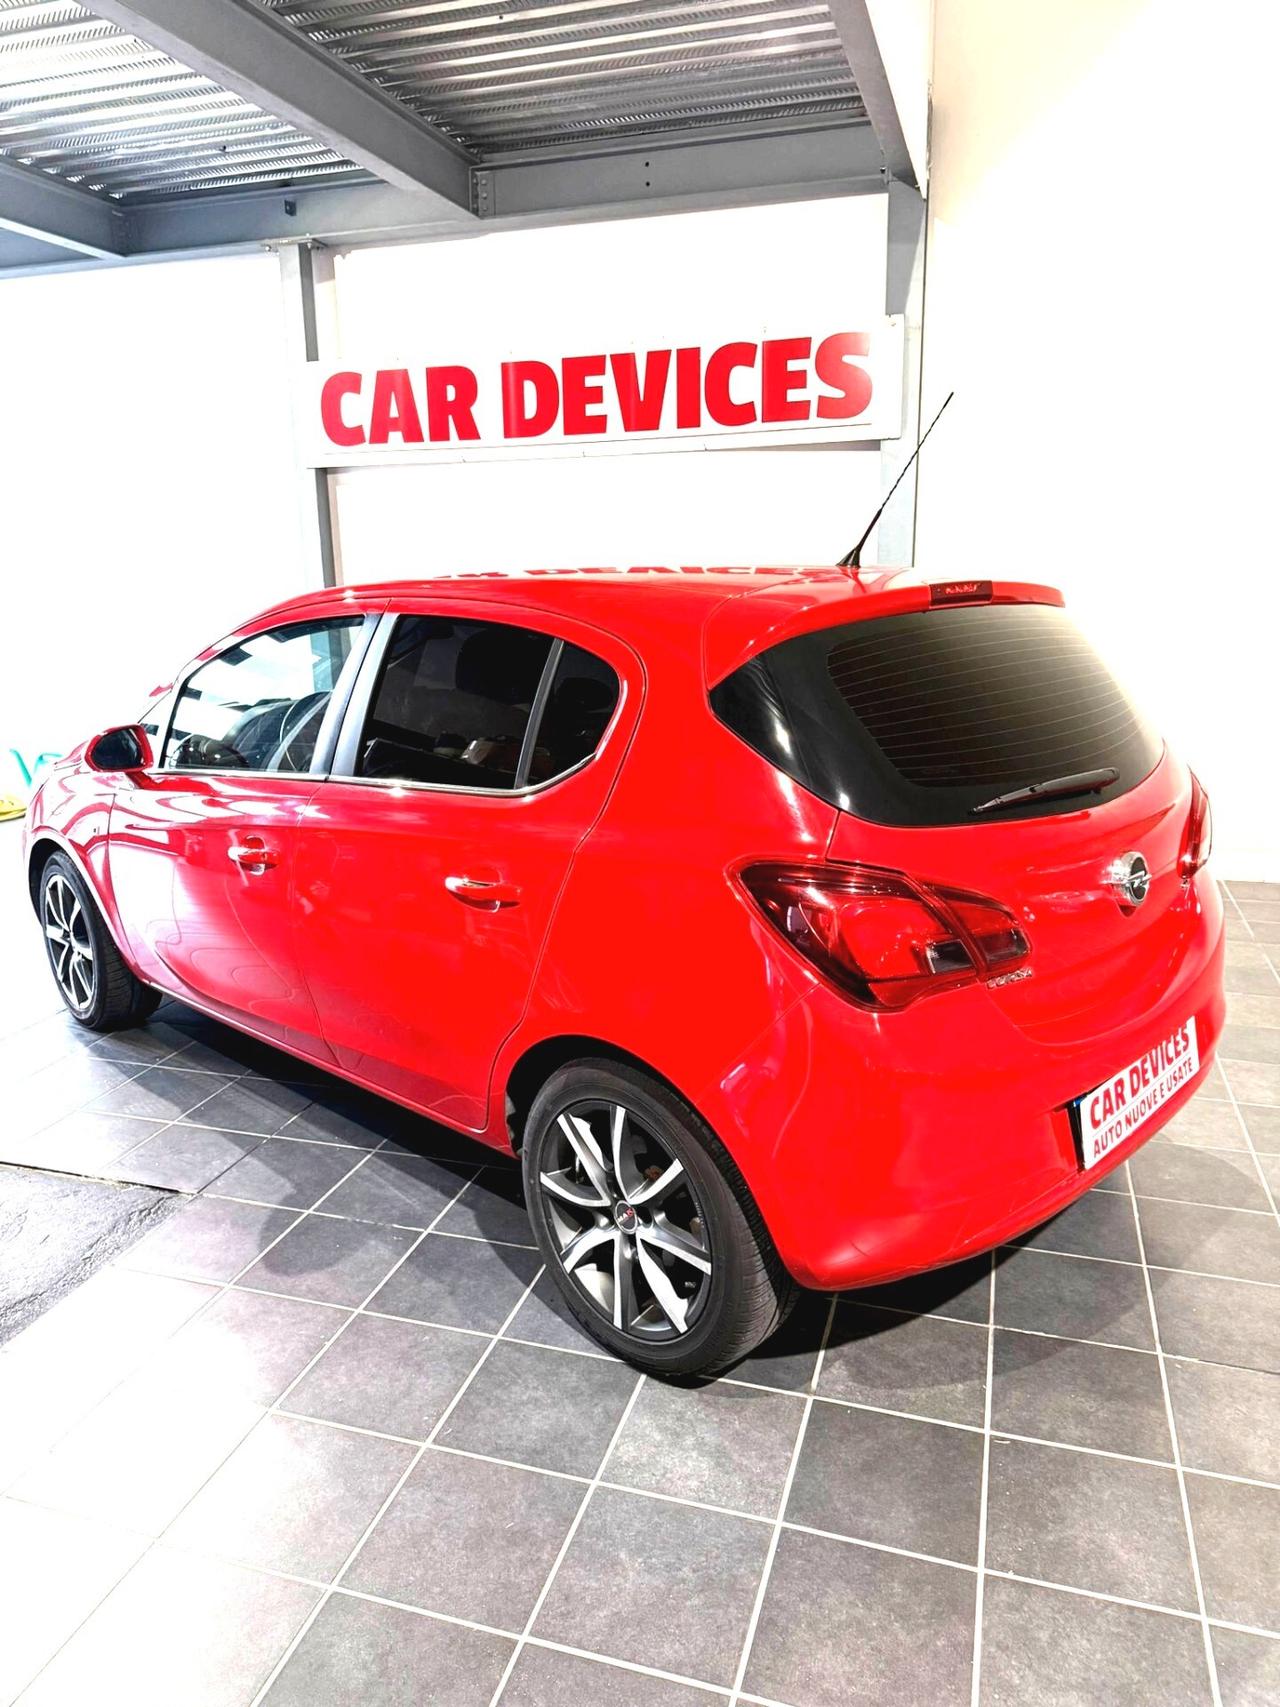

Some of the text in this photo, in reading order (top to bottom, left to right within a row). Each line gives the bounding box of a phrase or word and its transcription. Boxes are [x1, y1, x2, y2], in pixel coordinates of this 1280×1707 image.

[321, 332, 873, 447] CAR DEVICES
[1090, 1025, 1190, 1130] CAR DEVICES
[1093, 1057, 1193, 1158] AUTO NUOVE E USATE
